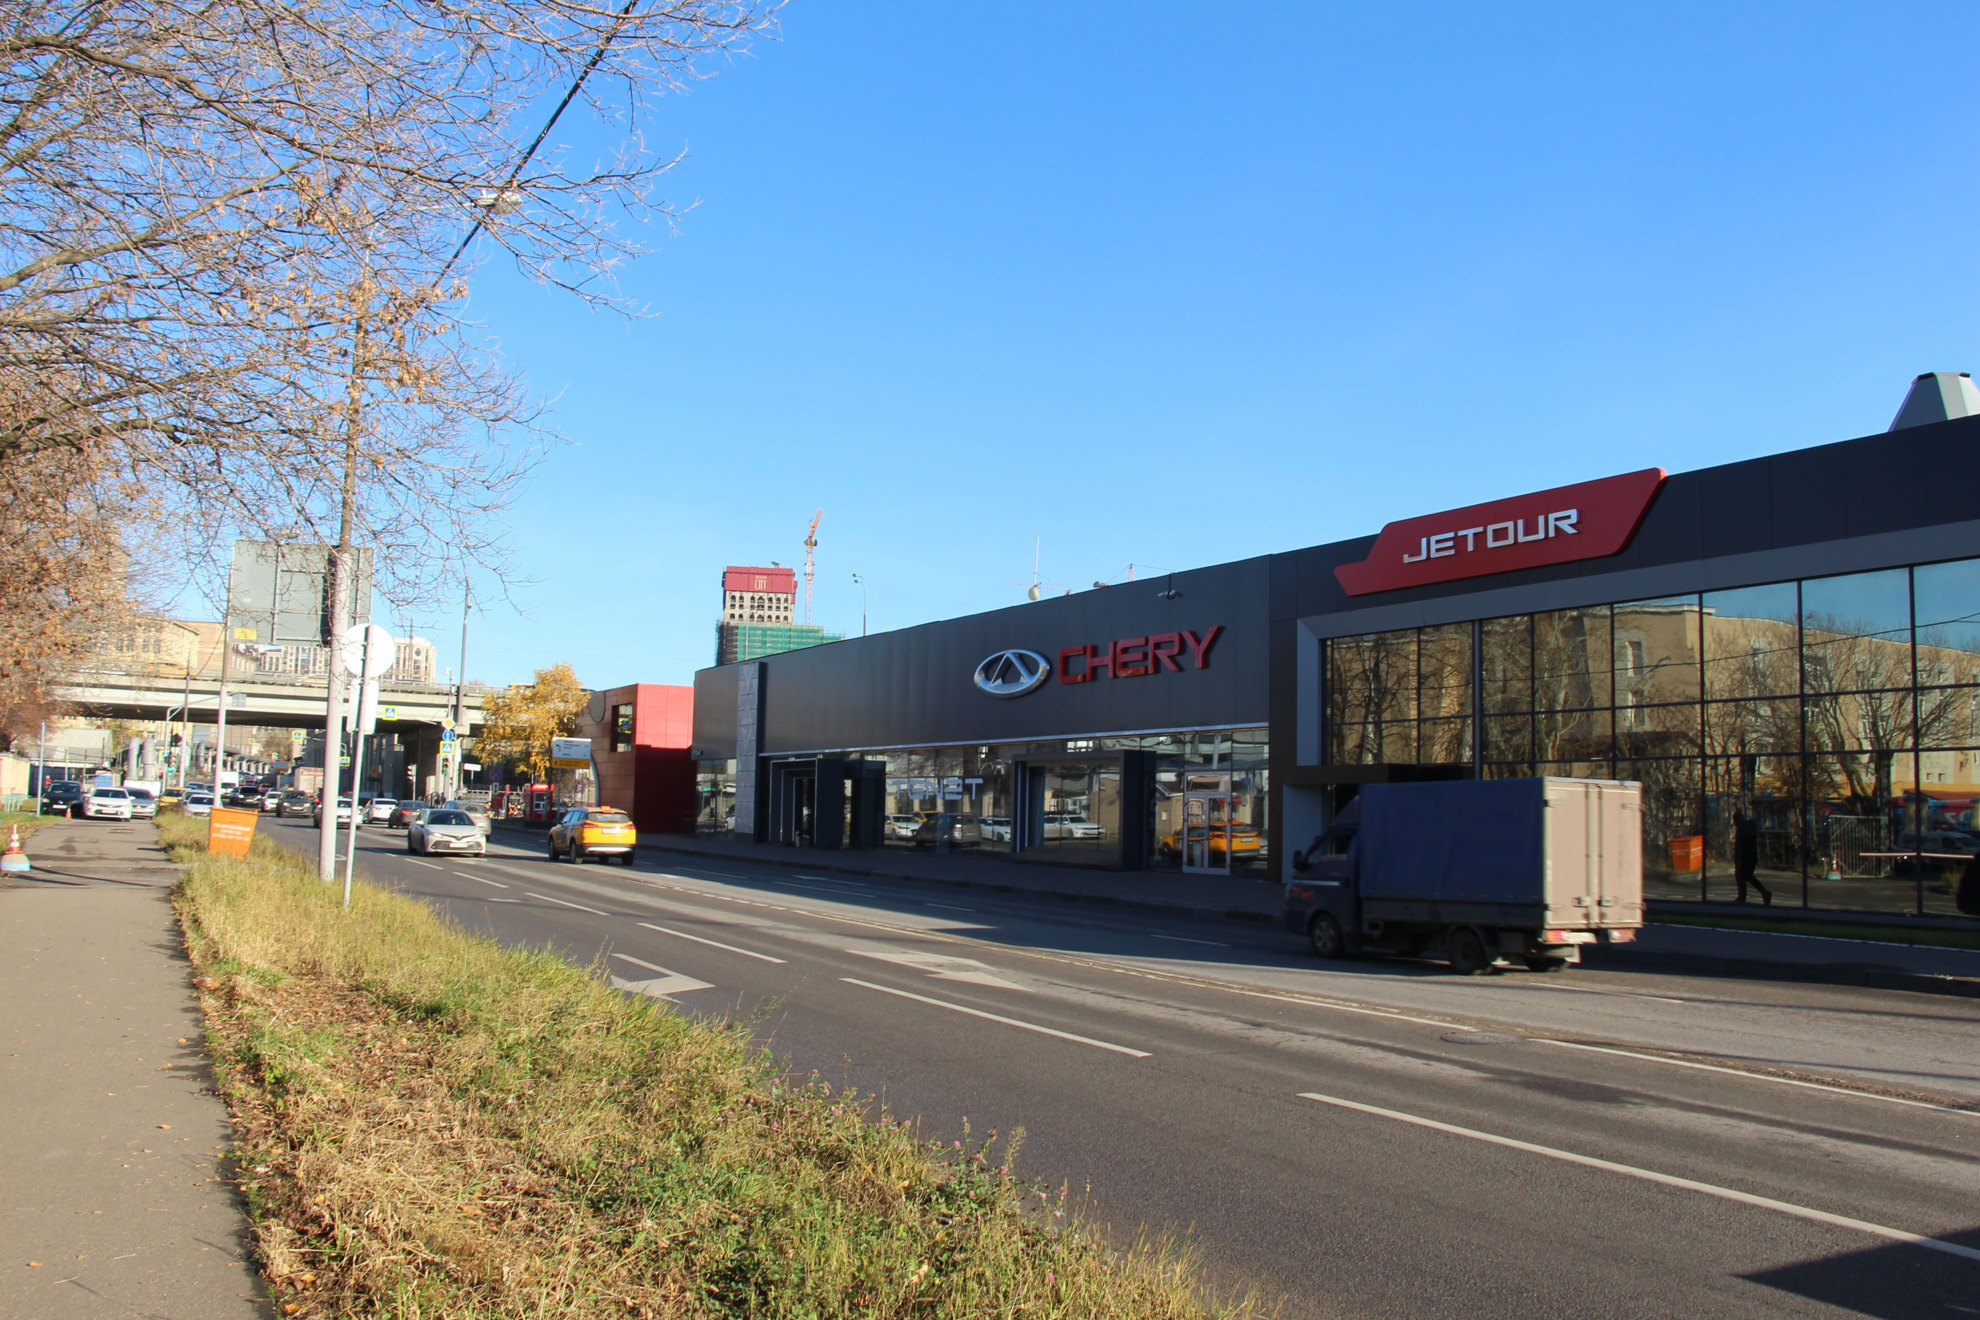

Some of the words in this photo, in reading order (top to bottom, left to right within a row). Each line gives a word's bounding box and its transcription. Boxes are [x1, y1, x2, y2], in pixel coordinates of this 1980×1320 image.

[1403, 508, 1578, 563] JETOUR
[1058, 625, 1224, 684] CHERY
[892, 778, 984, 800] TENET
